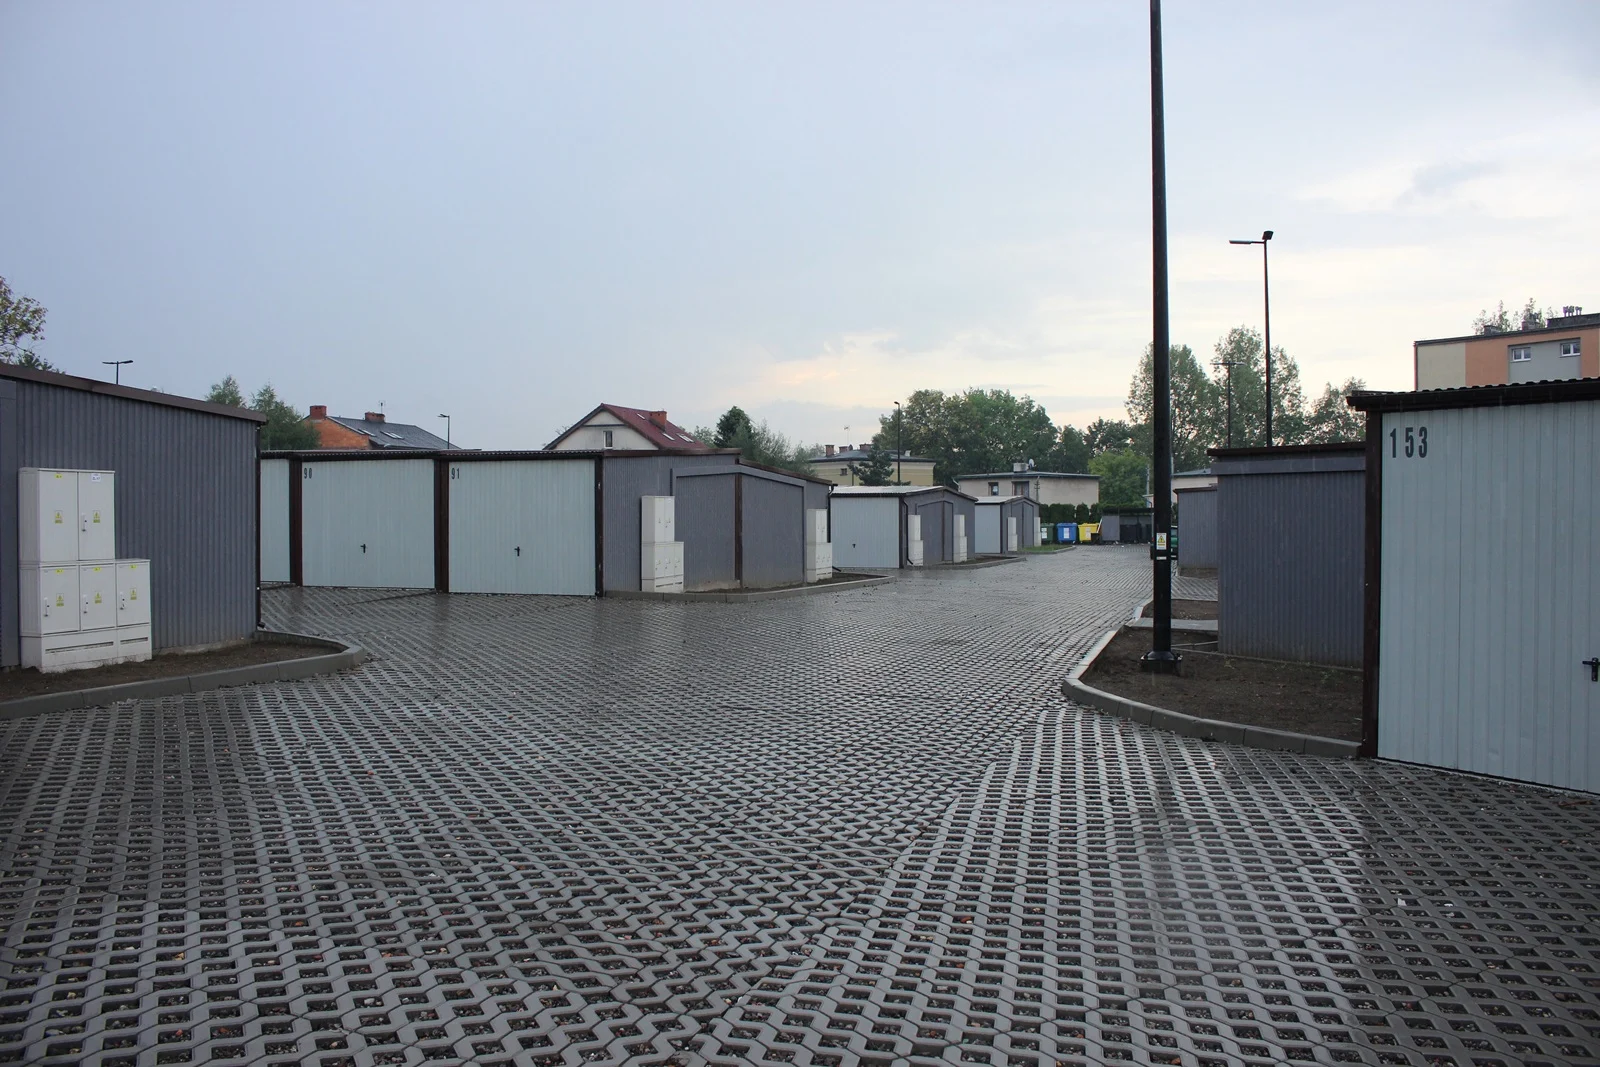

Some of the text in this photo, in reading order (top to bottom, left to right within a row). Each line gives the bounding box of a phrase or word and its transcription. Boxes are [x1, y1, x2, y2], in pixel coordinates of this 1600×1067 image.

[1390, 426, 1427, 458] 153
[304, 467, 313, 479] 90
[451, 467, 460, 480] 91
